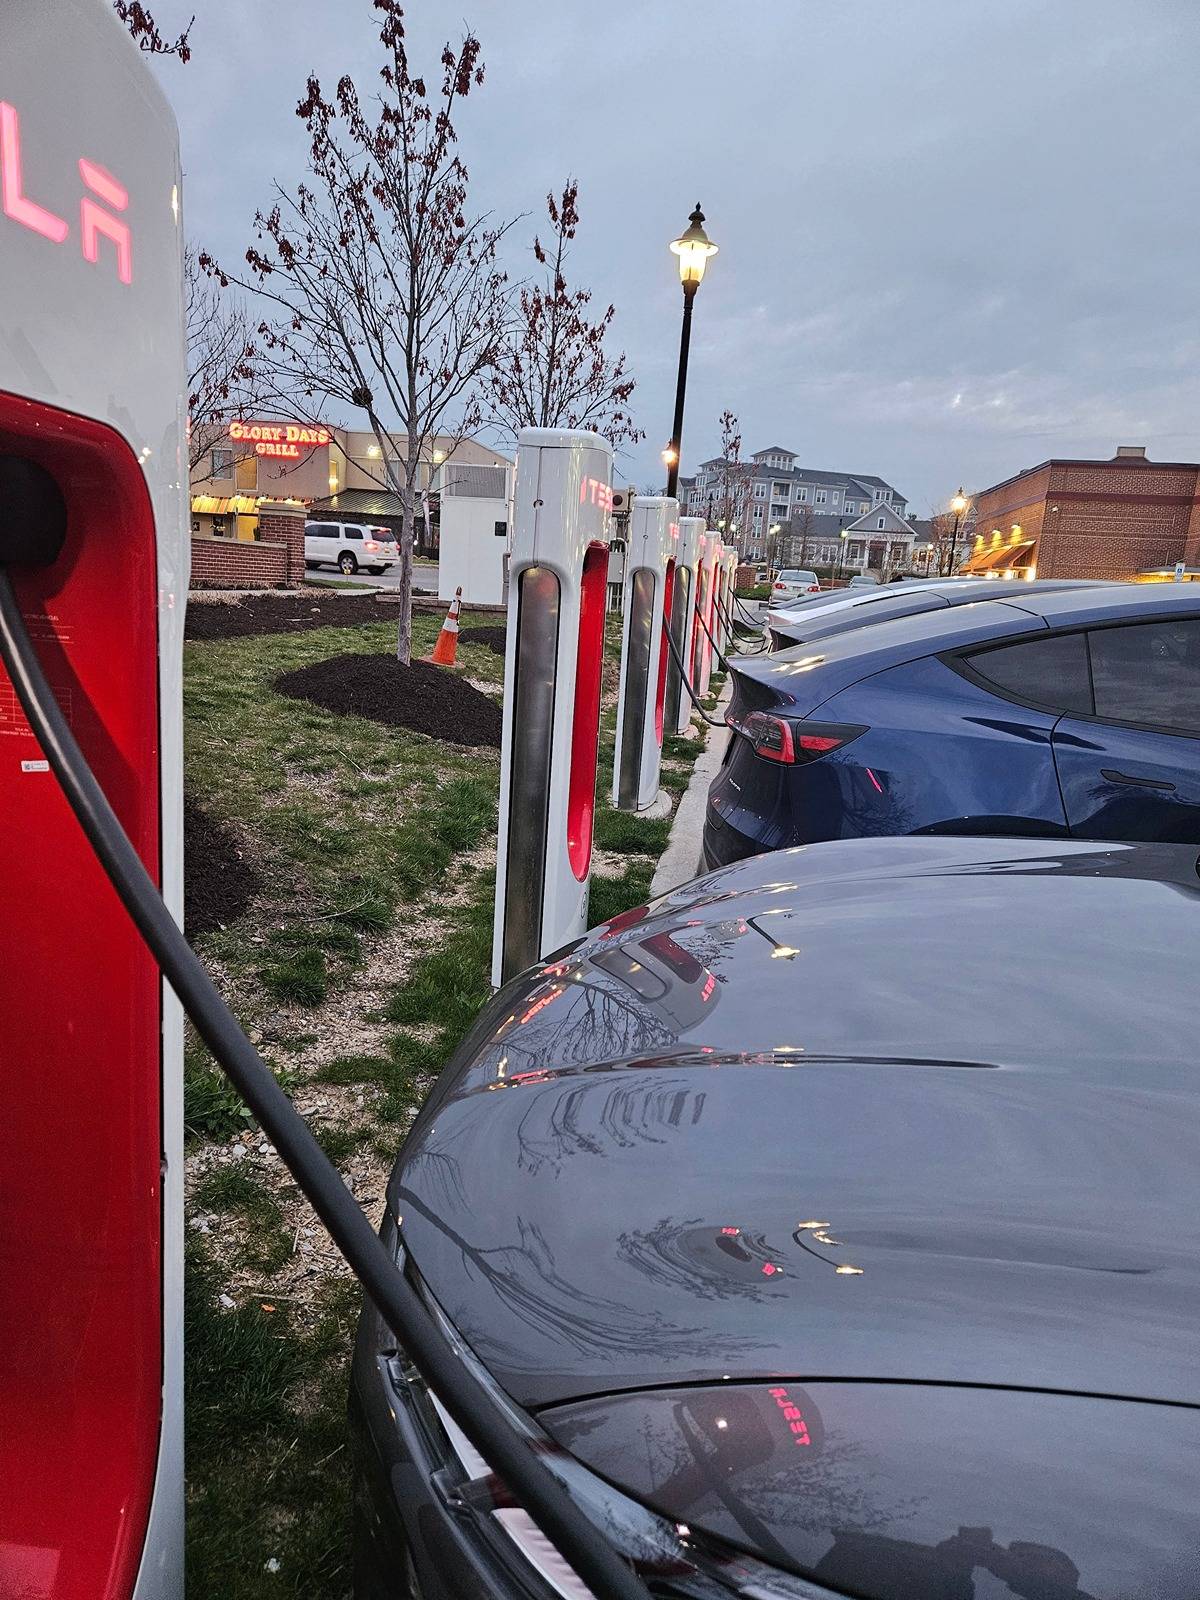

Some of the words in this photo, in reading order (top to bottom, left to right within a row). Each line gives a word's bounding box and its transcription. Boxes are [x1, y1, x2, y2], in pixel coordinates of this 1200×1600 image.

[229, 422, 282, 440] GLORY
[286, 426, 332, 442] DAYS
[256, 443, 298, 456] GRILL
